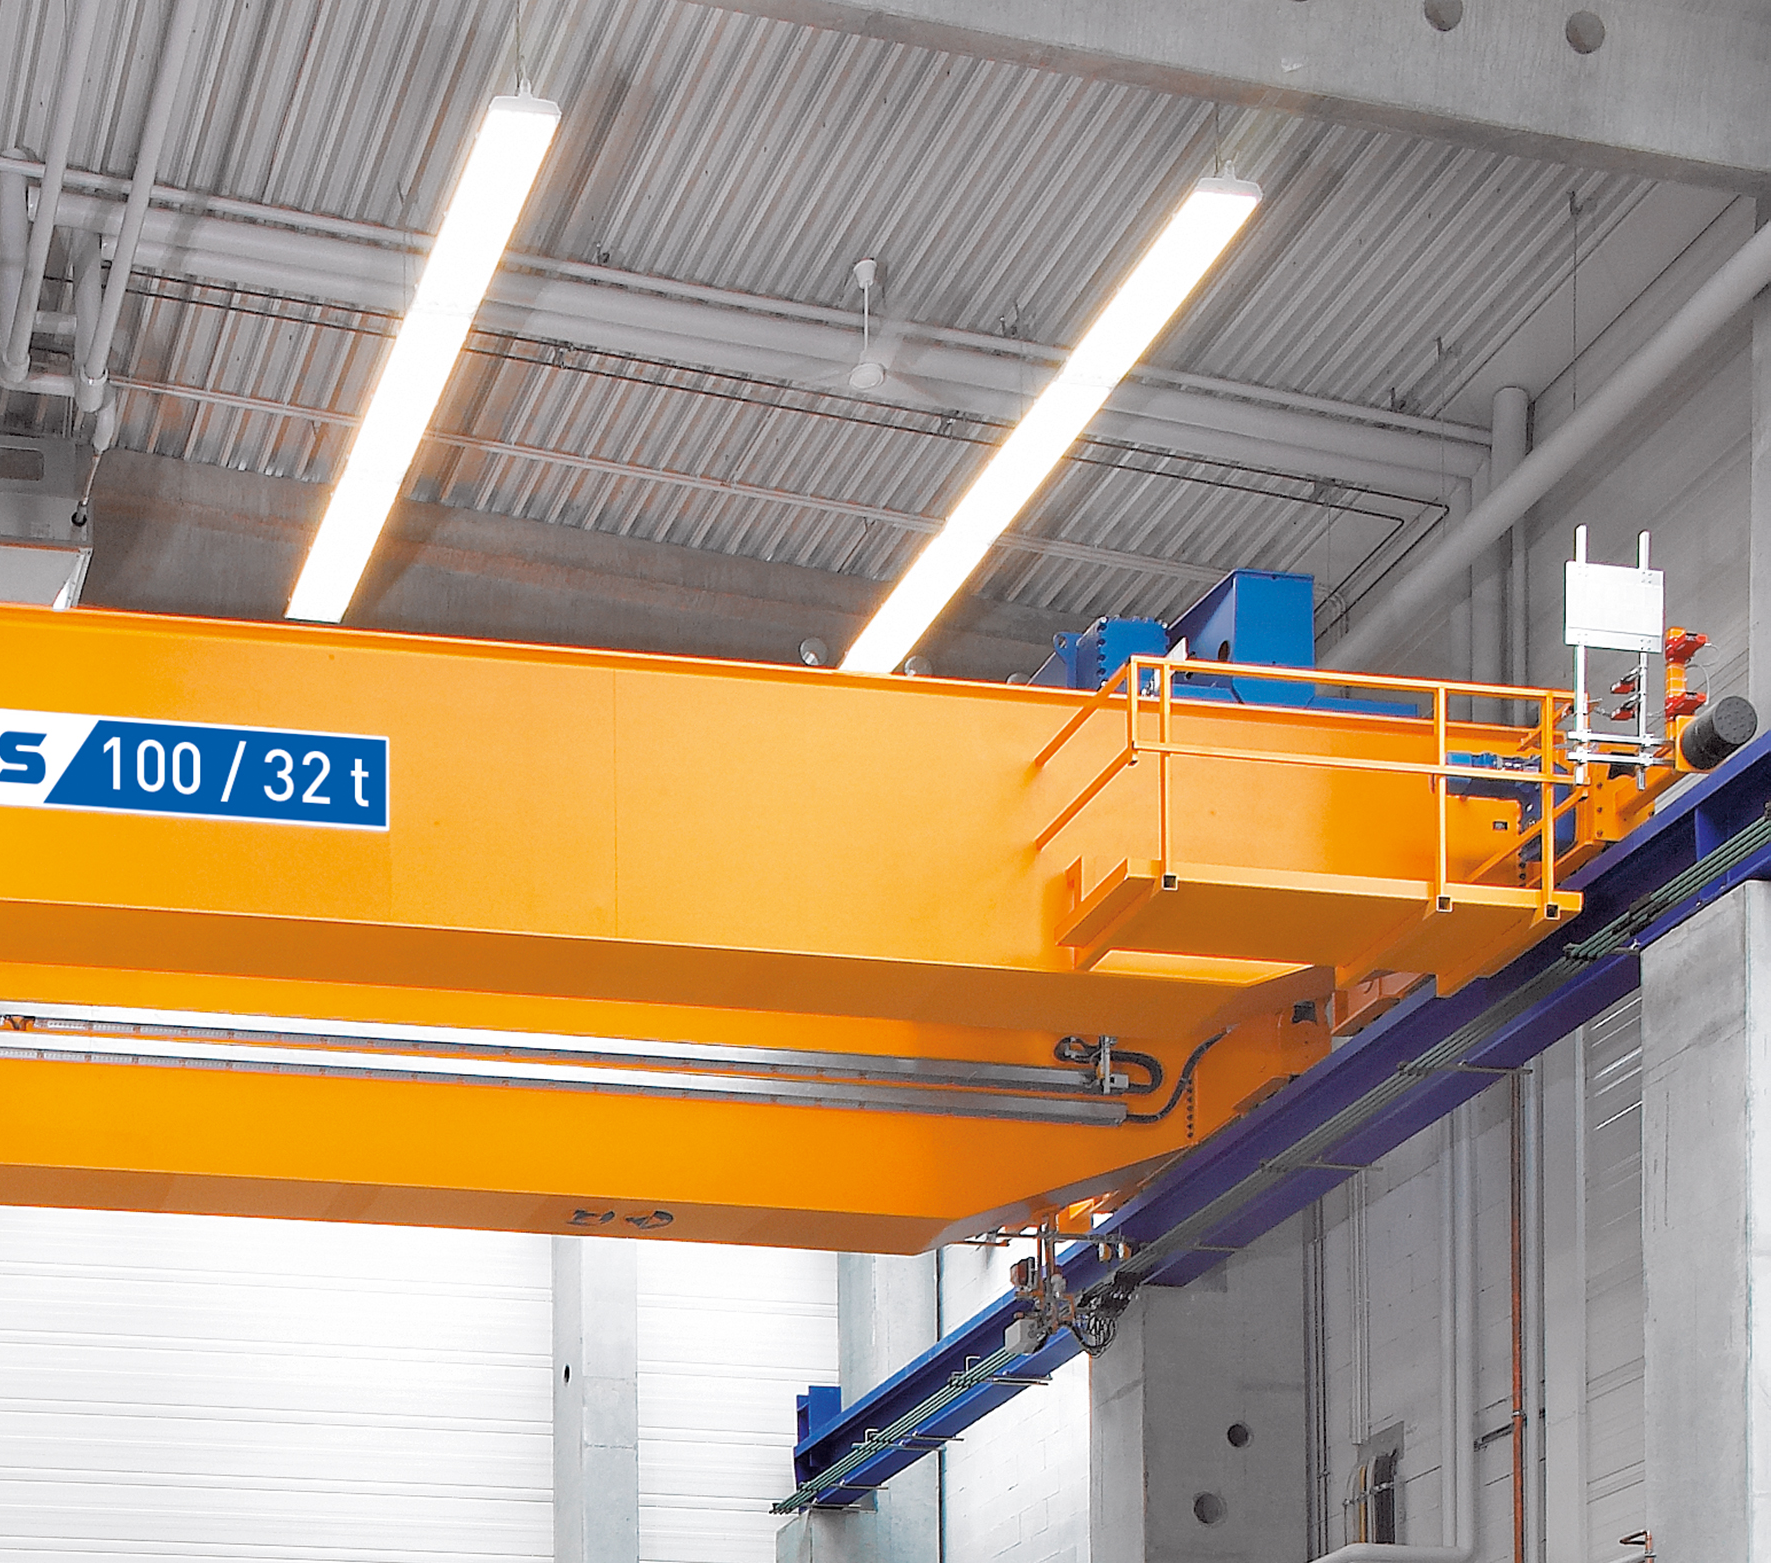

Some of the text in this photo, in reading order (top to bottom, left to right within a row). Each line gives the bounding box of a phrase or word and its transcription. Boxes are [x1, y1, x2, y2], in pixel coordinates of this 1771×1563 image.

[102, 736, 202, 795] 100
[220, 740, 247, 802] /
[264, 748, 331, 804] 32
[351, 758, 370, 807] t
